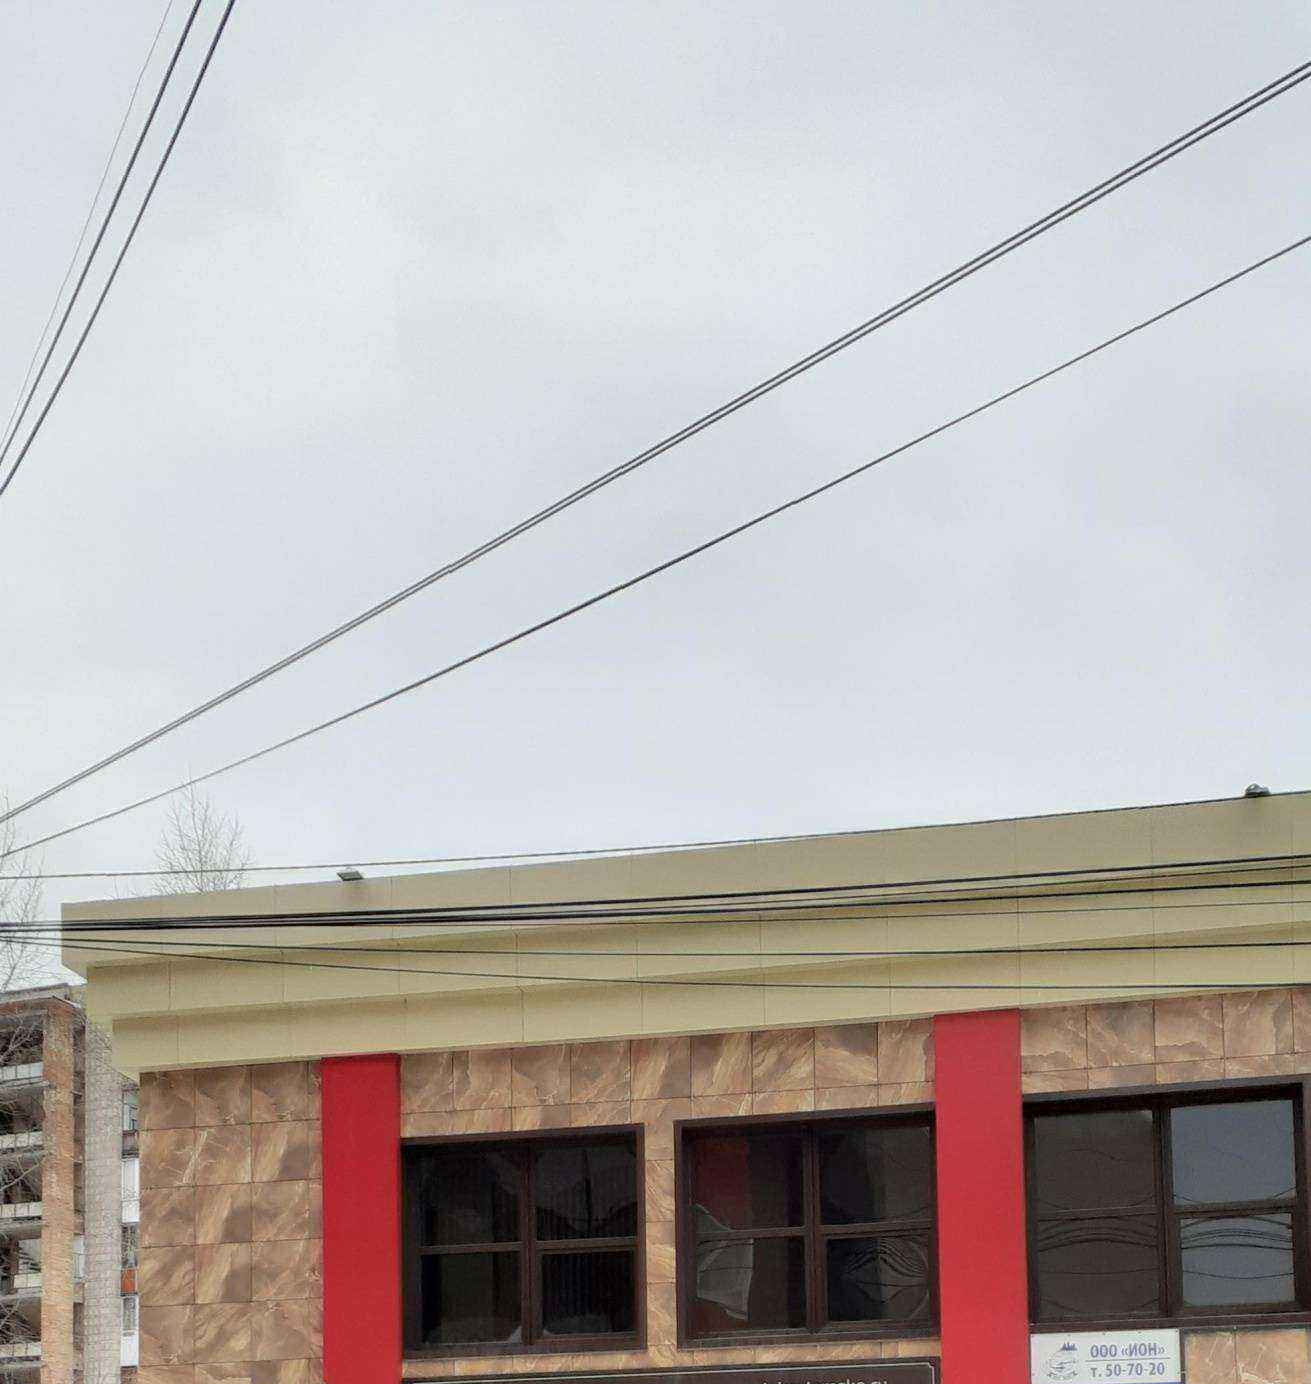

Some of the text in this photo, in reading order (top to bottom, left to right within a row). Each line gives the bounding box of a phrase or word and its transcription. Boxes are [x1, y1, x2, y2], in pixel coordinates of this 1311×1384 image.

[1090, 1342, 1165, 1358] ООО «ИОН»
[1105, 1362, 1165, 1377] 50-70-20
